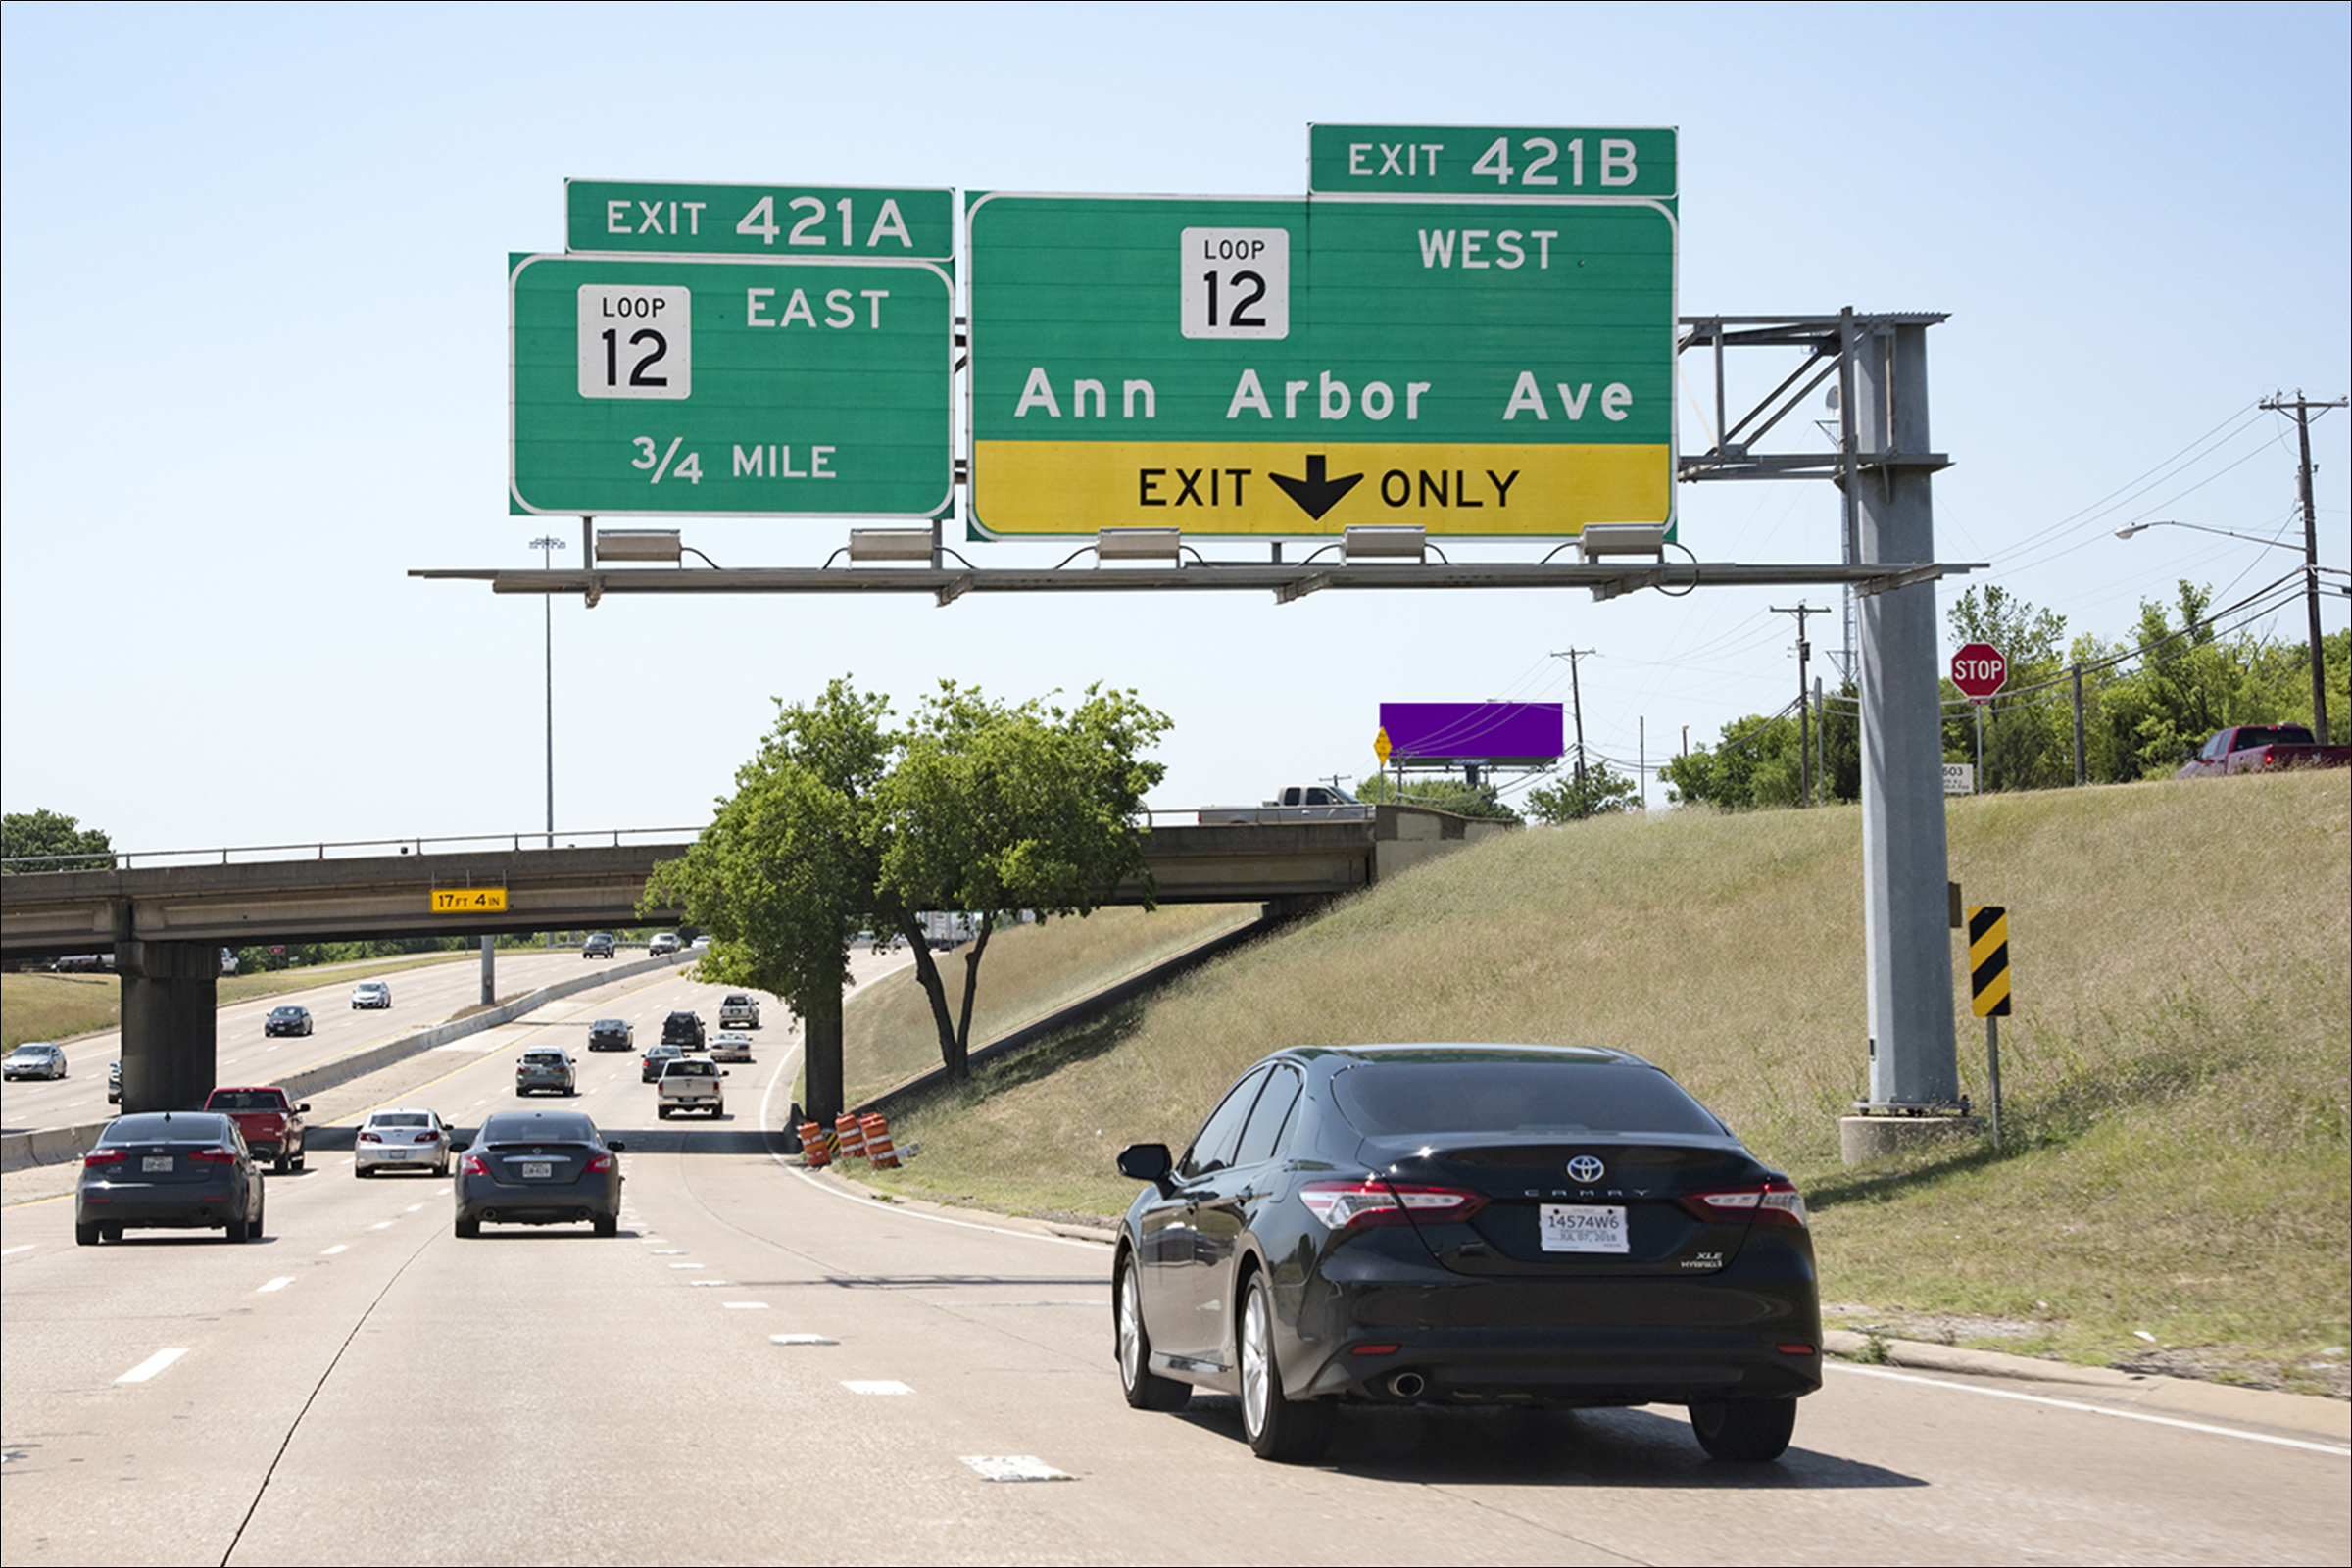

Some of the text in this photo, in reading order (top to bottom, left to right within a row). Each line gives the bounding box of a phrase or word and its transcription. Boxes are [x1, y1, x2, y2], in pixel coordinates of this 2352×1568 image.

[1350, 137, 1637, 186] EXIT 421B
[608, 196, 913, 248] EXIT 421A
[1205, 240, 1264, 259] LOOP
[1418, 229, 1558, 269] WEST
[604, 298, 665, 318] LOOP
[748, 288, 889, 328] EAST
[1204, 270, 1265, 326] 12
[603, 329, 667, 386] 12
[1014, 368, 1632, 420] Ann Arbor Ave
[733, 445, 836, 478] MILE
[1140, 469, 1520, 508] EXIT ONLY
[1955, 660, 2002, 680] STOP
[439, 893, 500, 907] 17 FT 4 IN
[1548, 1215, 1619, 1229] 14574W6
[1559, 1233, 1575, 1242] JUL
[1594, 1233, 1617, 1243] 2018
